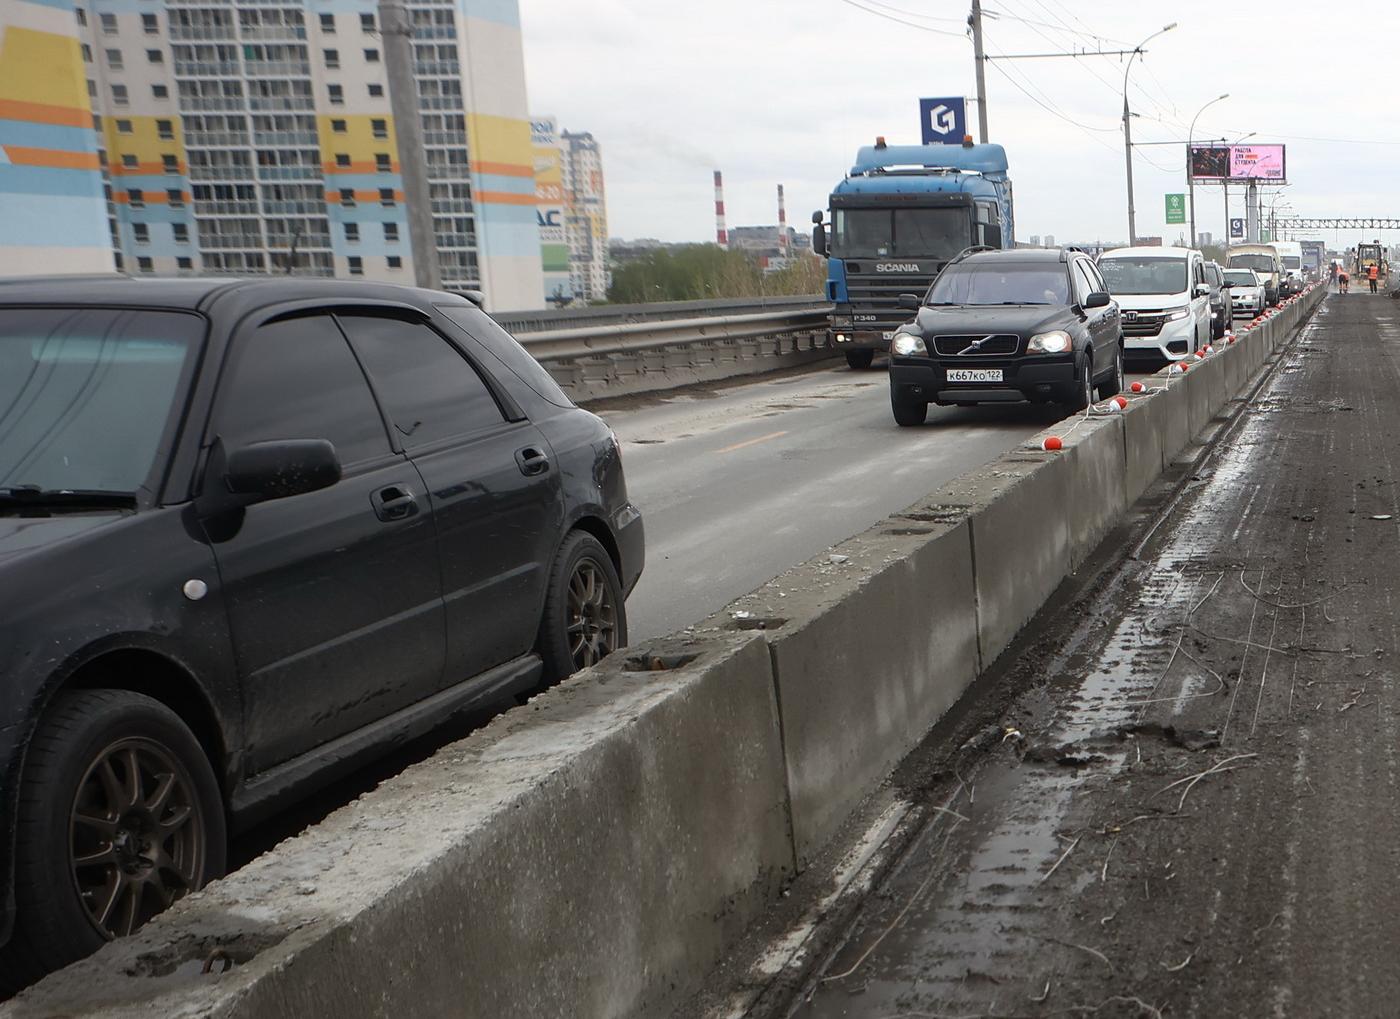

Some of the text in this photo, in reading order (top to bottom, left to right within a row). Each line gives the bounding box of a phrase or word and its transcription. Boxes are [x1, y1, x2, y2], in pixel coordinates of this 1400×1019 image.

[876, 263, 920, 273] SCANIA
[949, 371, 986, 381] К667КО
[986, 370, 1001, 378] 122
